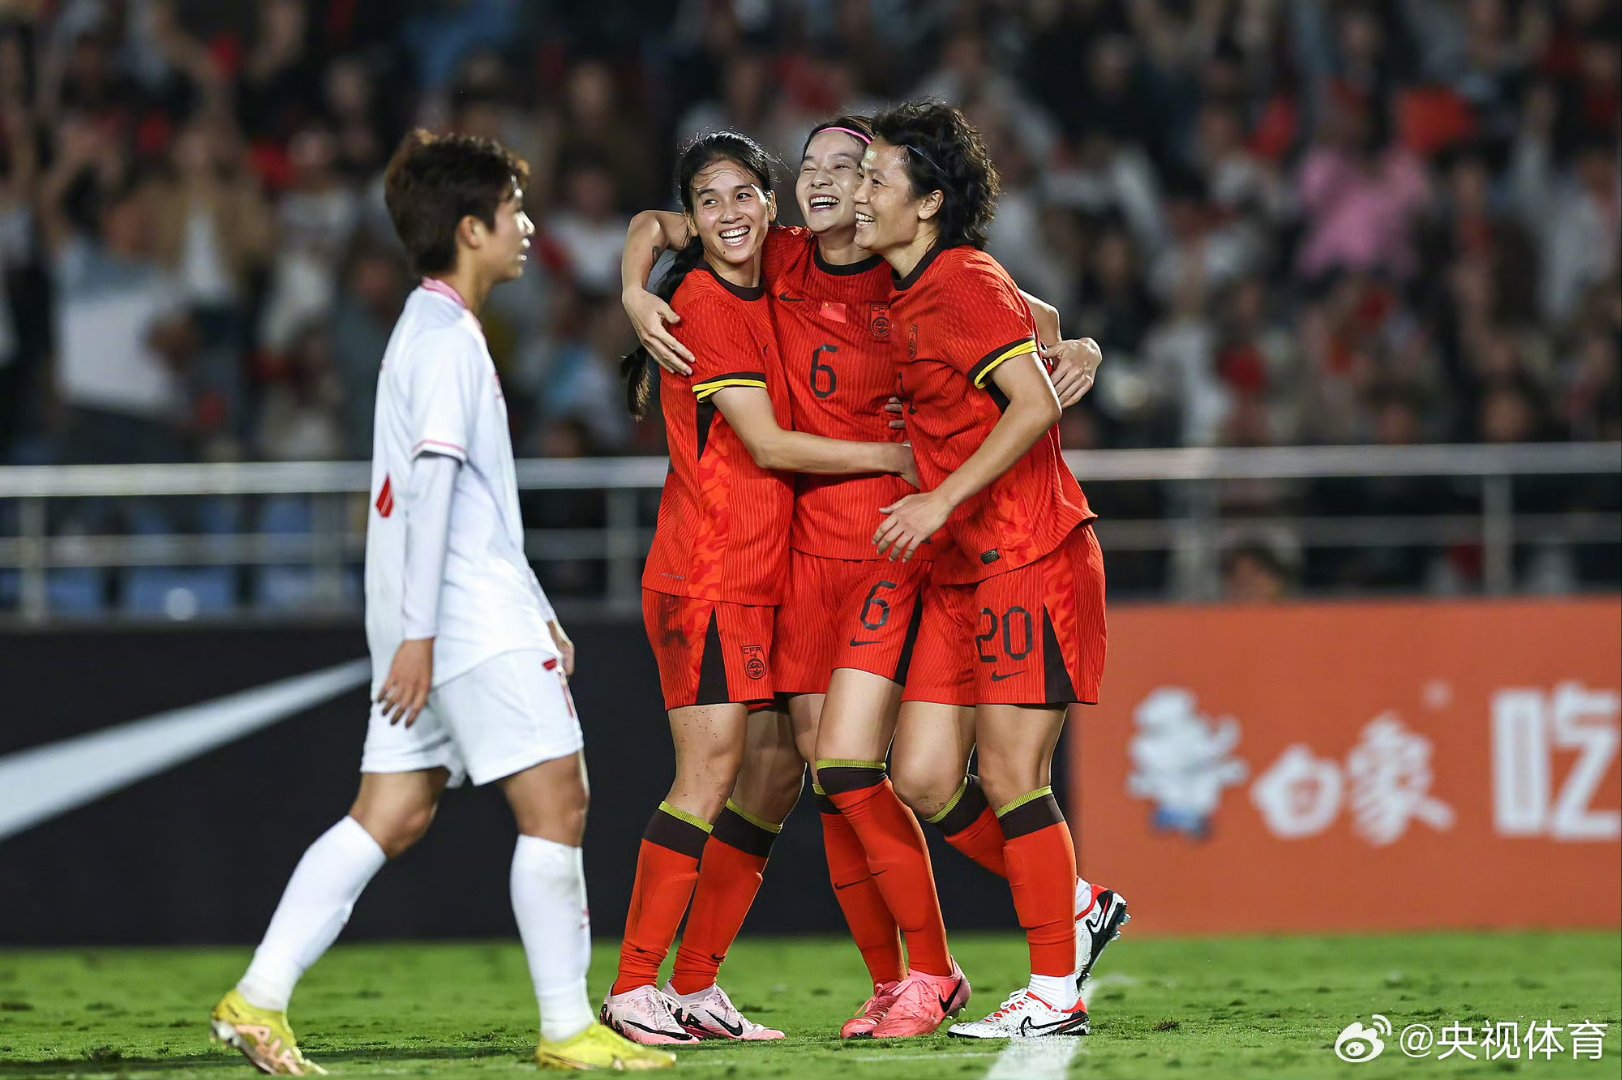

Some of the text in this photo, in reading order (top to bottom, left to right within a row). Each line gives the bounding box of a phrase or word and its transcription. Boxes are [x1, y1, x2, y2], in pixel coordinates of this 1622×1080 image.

[811, 345, 837, 398] 6
[861, 581, 897, 630] 6
[976, 606, 1034, 662] 20
